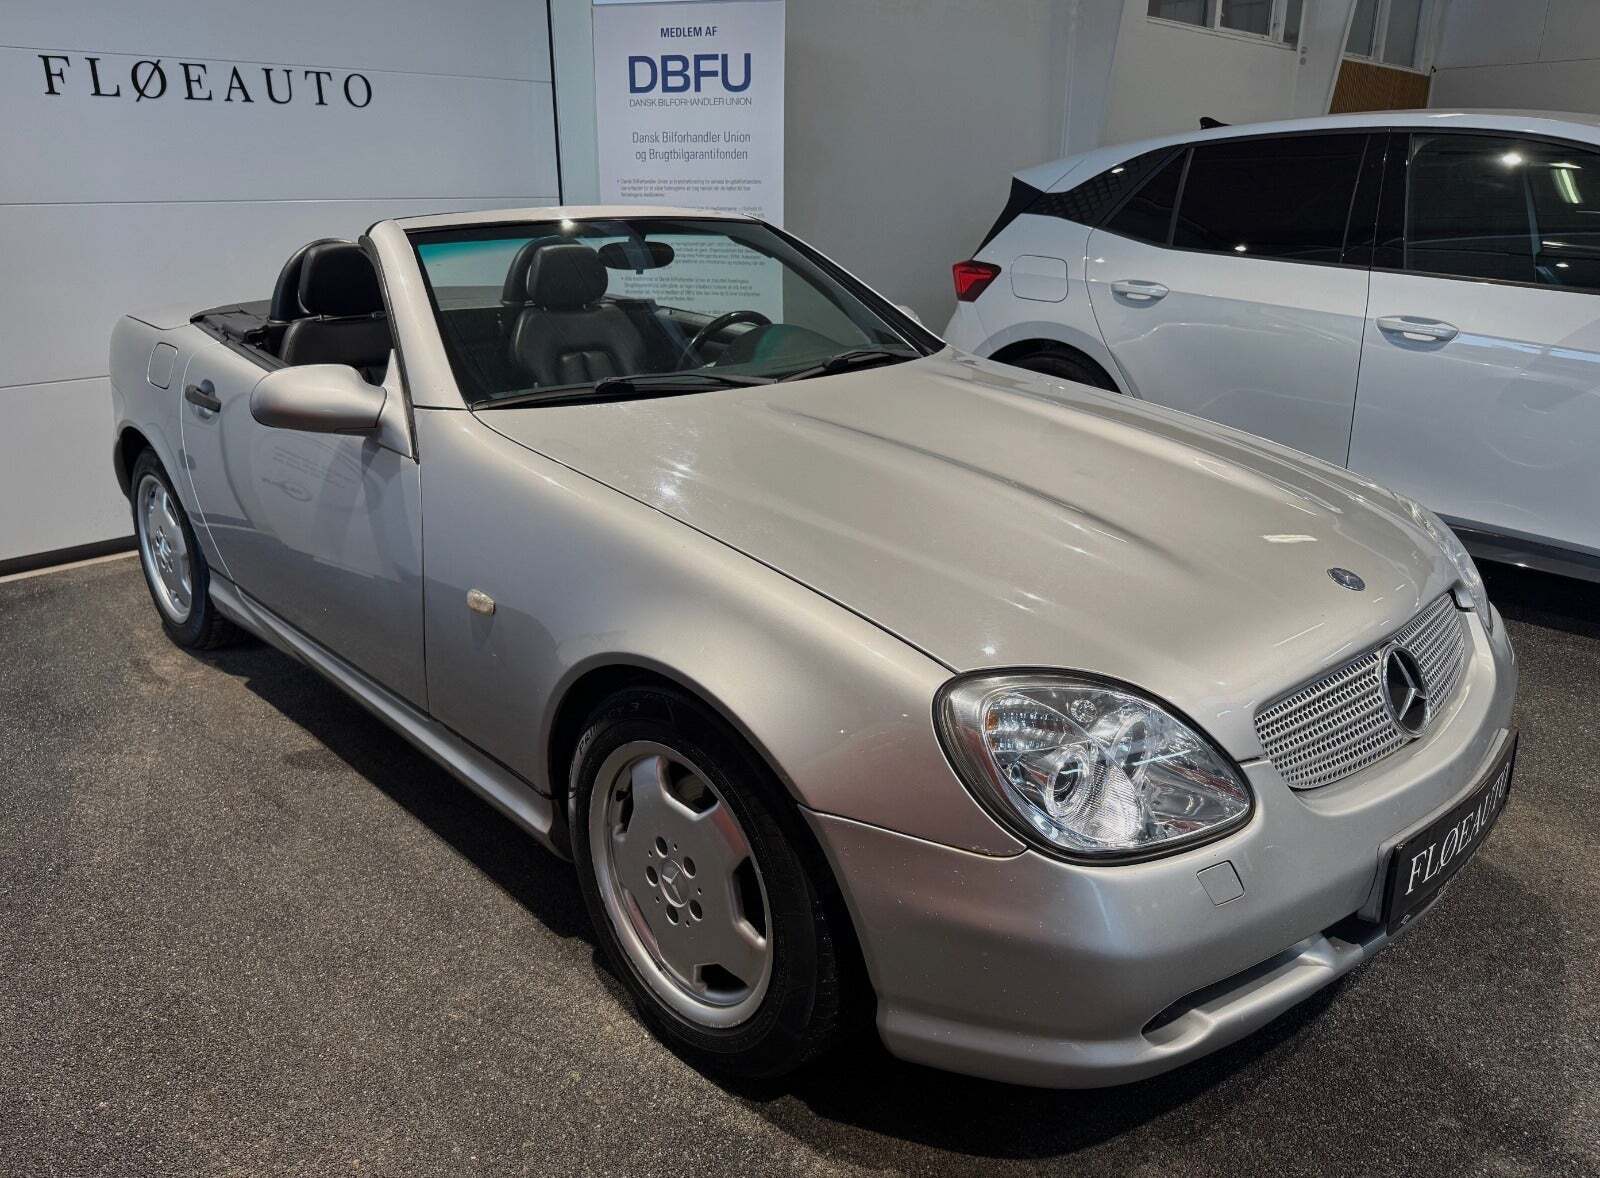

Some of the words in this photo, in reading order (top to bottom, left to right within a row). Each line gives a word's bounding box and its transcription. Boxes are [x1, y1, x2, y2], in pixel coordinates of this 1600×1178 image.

[660, 27, 702, 38] MEDLEM
[704, 26, 718, 37] AF
[37, 54, 373, 108] FLØEAUTO
[628, 53, 752, 94] DBFU
[629, 98, 657, 108] DANSK
[658, 97, 724, 107] BILFORHANDLER
[726, 97, 752, 107] UNION
[632, 132, 660, 144] Dansk
[662, 131, 722, 144] Bilforhandler
[724, 131, 751, 143] Union
[635, 151, 647, 163] og
[649, 148, 748, 163] Brugtbilgarantifonden
[1404, 762, 1511, 895] FLØEAUTO
